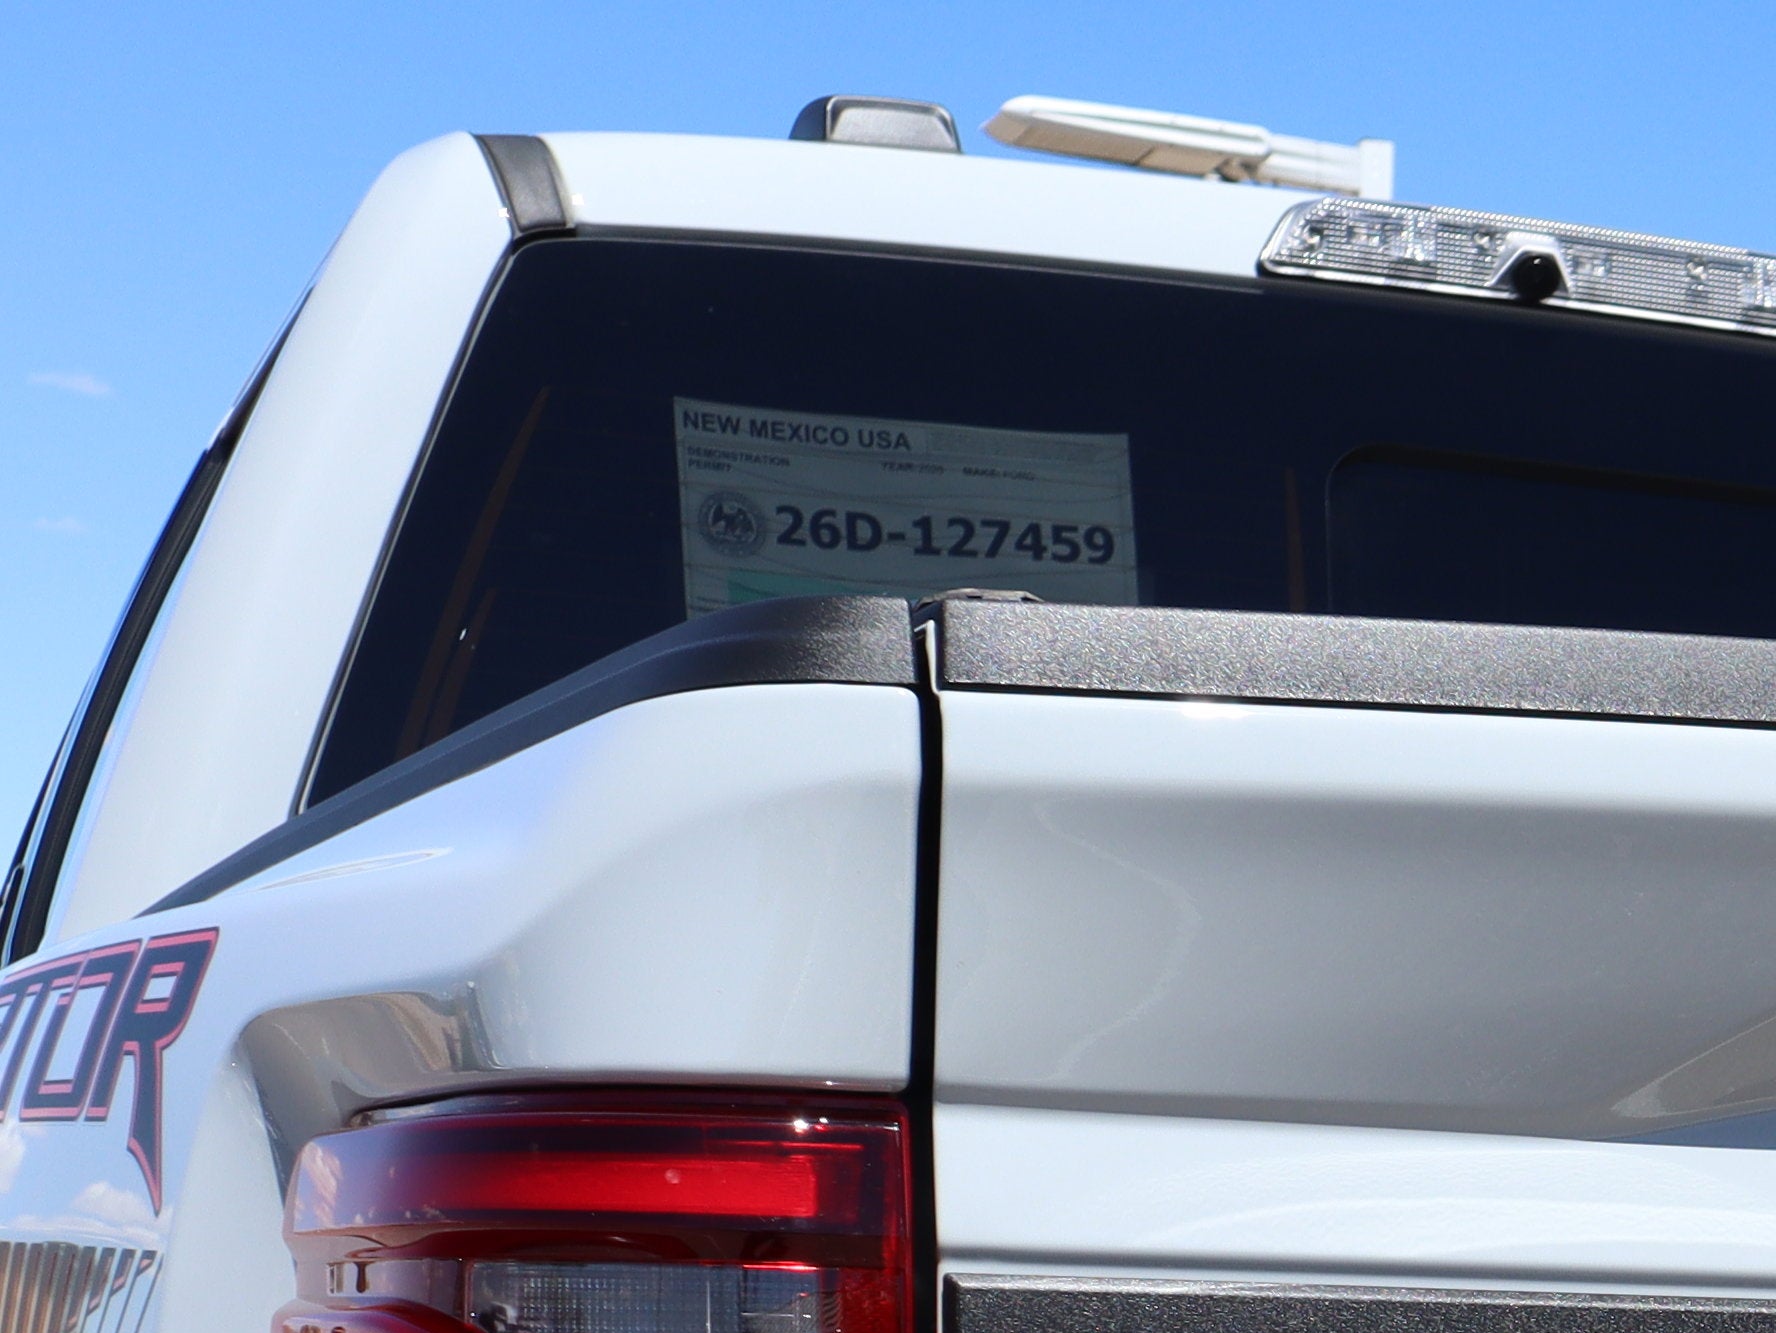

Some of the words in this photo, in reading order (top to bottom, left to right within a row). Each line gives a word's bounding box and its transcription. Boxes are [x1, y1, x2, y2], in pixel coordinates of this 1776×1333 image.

[682, 409, 741, 436] NEW
[749, 418, 850, 447] MEXICO
[857, 429, 912, 452] USA
[775, 504, 1116, 566] 26D-127459
[0, 926, 220, 1218] TOR
